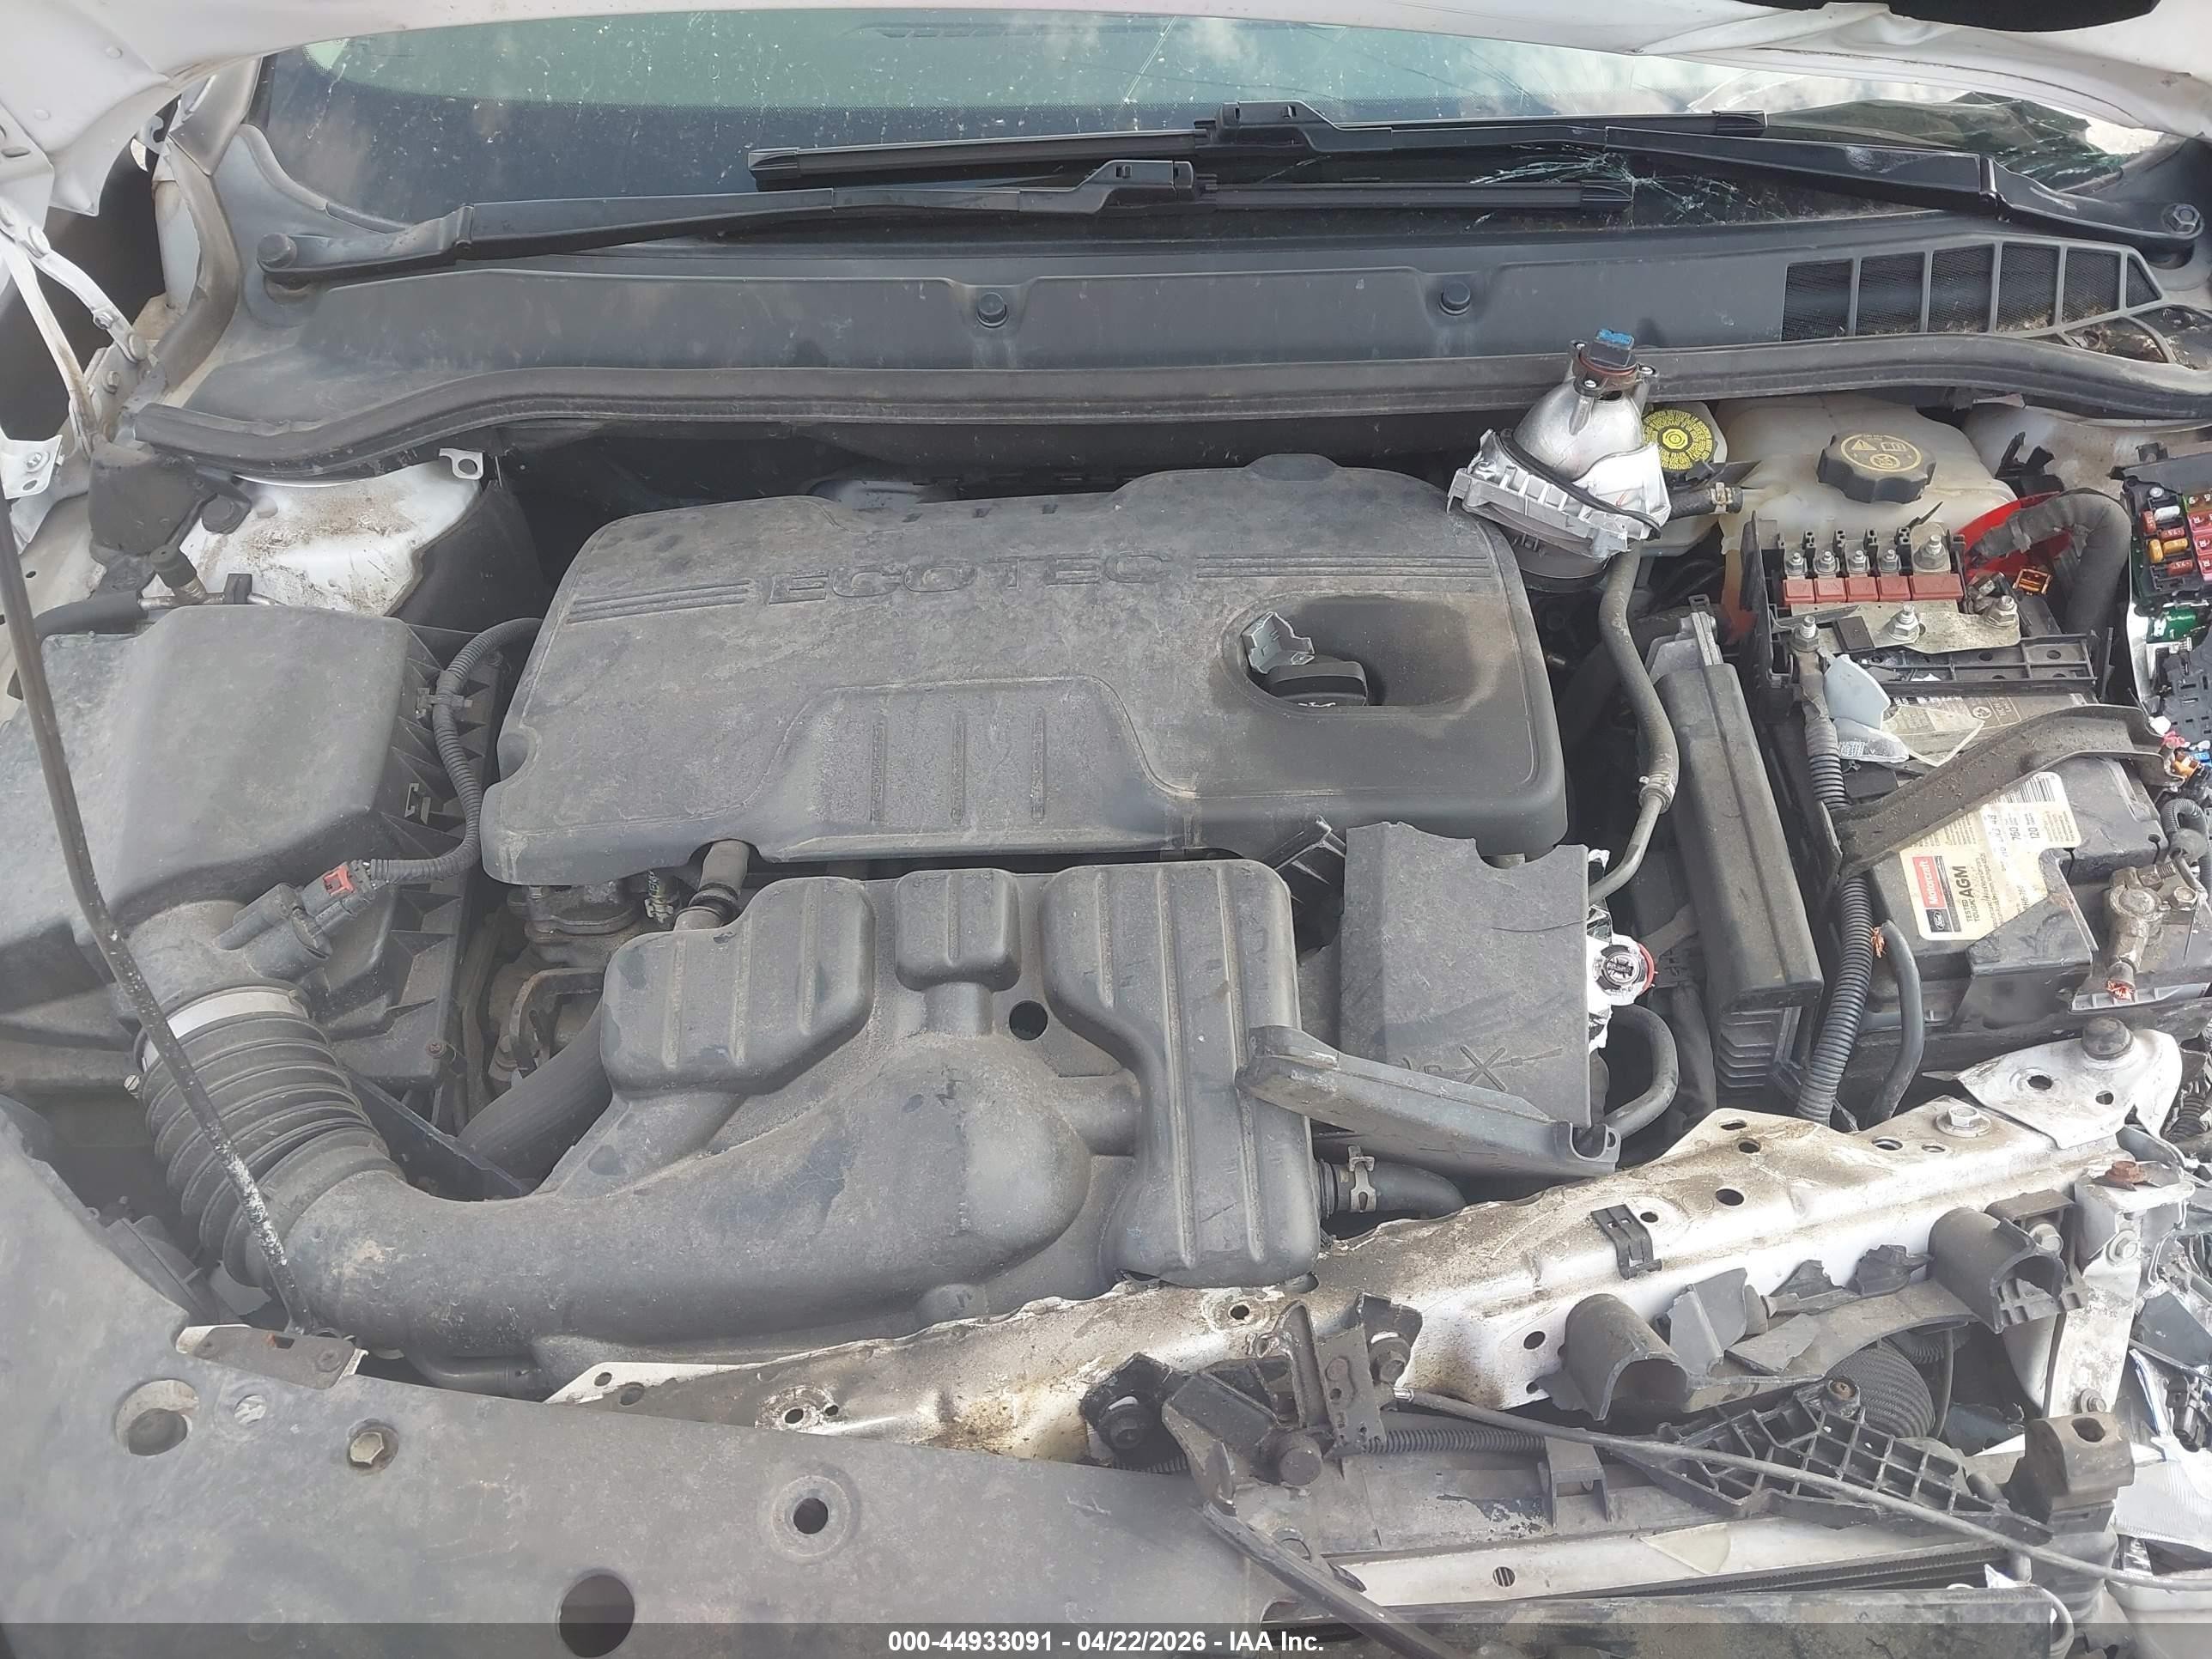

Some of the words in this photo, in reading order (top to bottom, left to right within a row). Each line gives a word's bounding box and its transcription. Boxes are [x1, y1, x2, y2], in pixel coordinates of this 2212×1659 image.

[769, 552, 1172, 605] ECOTEC
[2027, 826, 2040, 840] 120
[1918, 860, 1939, 905] Motorcraft
[1952, 866, 1975, 898] AGM
[1961, 899, 1973, 922] TESTED
